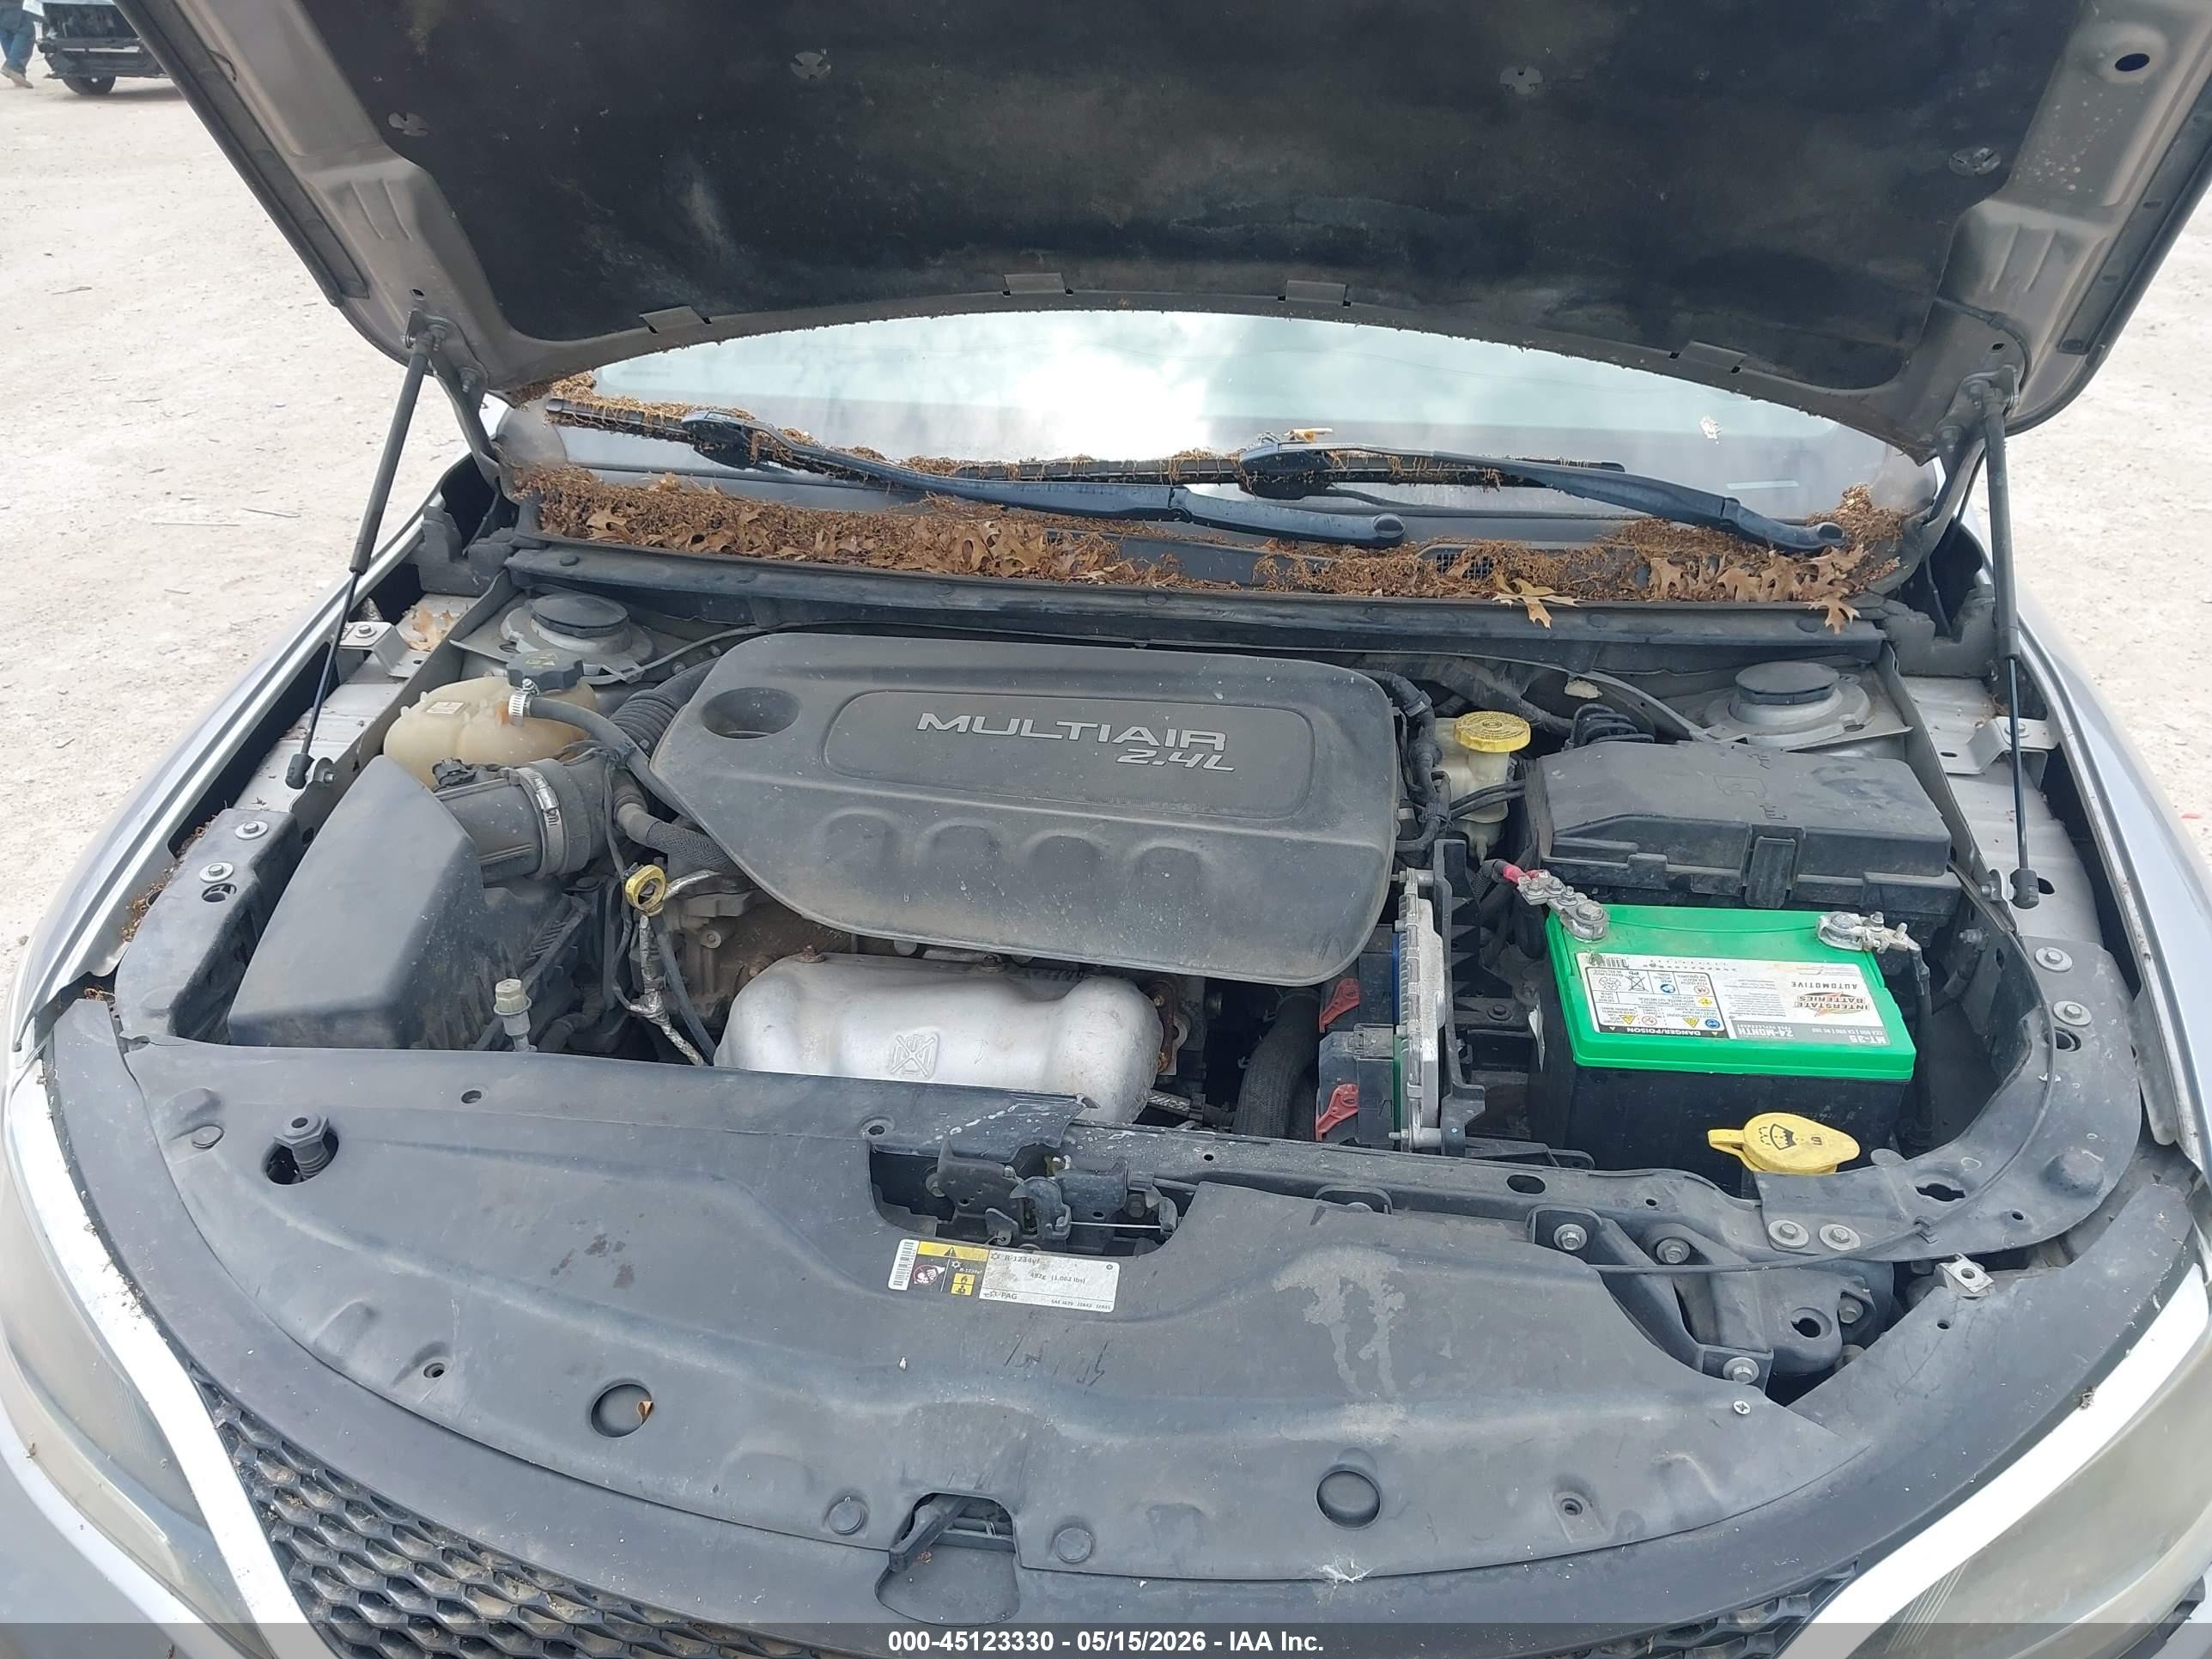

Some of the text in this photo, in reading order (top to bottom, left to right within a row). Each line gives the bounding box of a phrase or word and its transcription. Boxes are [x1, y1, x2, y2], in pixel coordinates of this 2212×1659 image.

[916, 712, 1228, 752] MULTIAIR
[1115, 747, 1237, 773] 2.4L
[1796, 1001, 1869, 1010] INTERSTATE
[1626, 1027, 1701, 1036] DANGER/POISON
[1738, 1028, 1794, 1036] 24-MONTH
[1849, 1035, 1887, 1044] MT-35
[1004, 1255, 1041, 1265] R-1234yf
